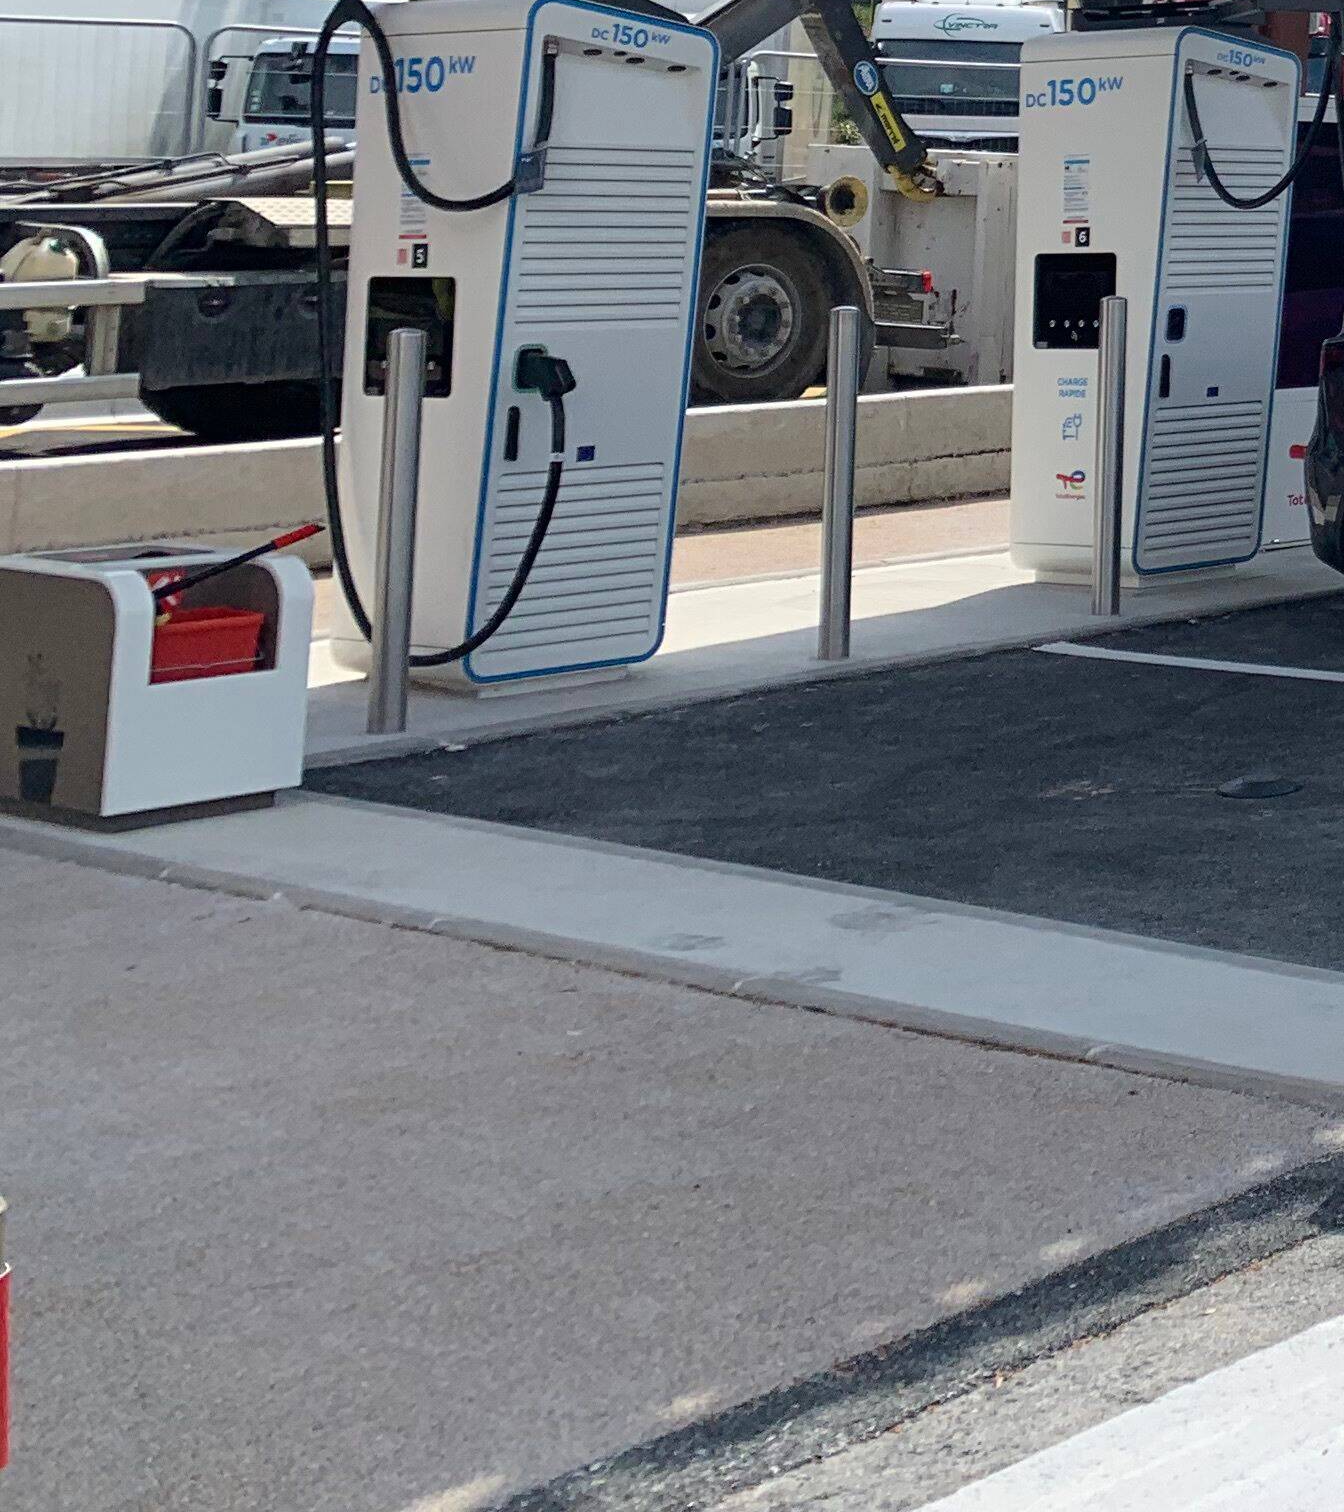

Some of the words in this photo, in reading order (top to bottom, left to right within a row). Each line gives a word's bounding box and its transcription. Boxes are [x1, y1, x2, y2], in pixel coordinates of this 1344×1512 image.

[592, 28, 609, 40] DC
[612, 23, 649, 48] 150
[1229, 49, 1253, 67] 150
[394, 56, 445, 94] 150
[449, 55, 476, 74] kW
[1026, 93, 1046, 107] DC
[1047, 77, 1097, 107] 150
[1099, 76, 1124, 92] kW
[1078, 230, 1087, 243] 6
[416, 248, 425, 264] 5
[1057, 377, 1088, 387] CHARGE
[1058, 389, 1086, 398] RAPIDE
